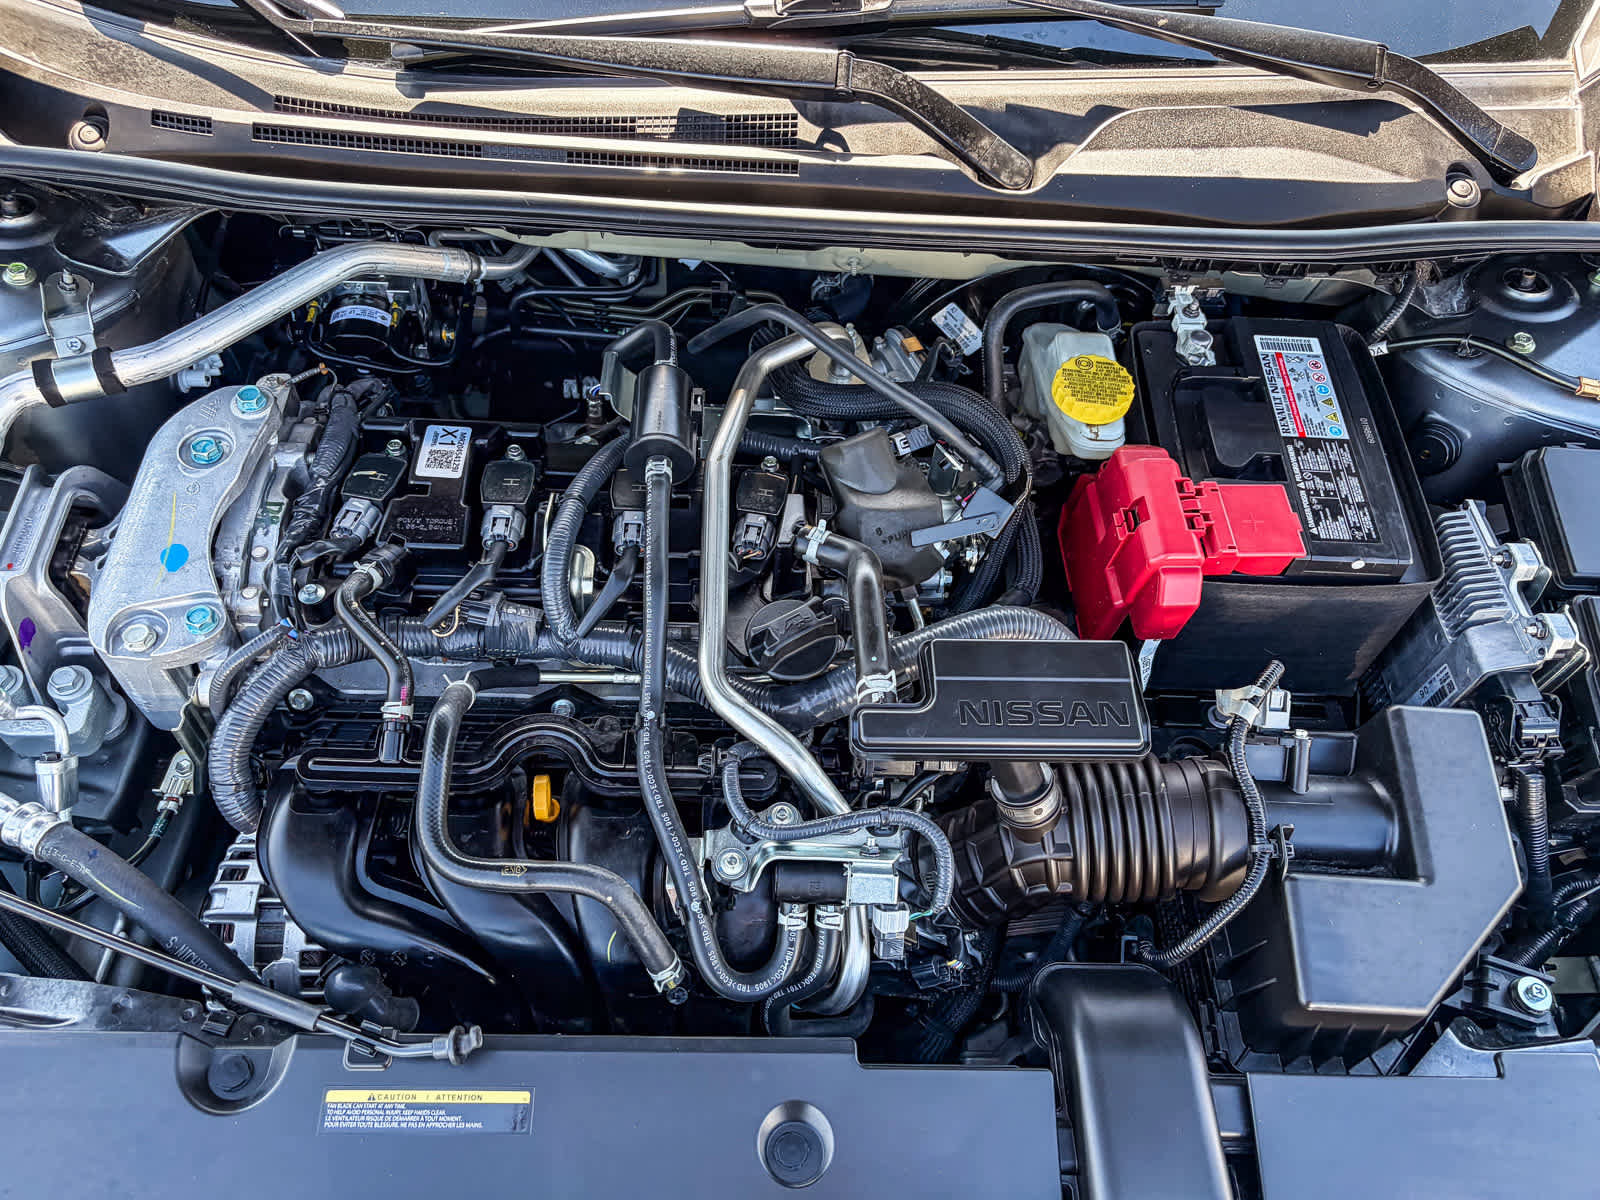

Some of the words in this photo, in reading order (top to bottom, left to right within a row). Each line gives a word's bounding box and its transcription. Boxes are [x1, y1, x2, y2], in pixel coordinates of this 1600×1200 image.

[1262, 354, 1280, 393] NISSAN
[1274, 394, 1291, 434] RENAULT
[438, 427, 460, 446] X1
[959, 700, 1132, 728] NISSAN
[377, 1093, 417, 1101] CAUTION
[435, 1093, 483, 1101] ATTENTION
